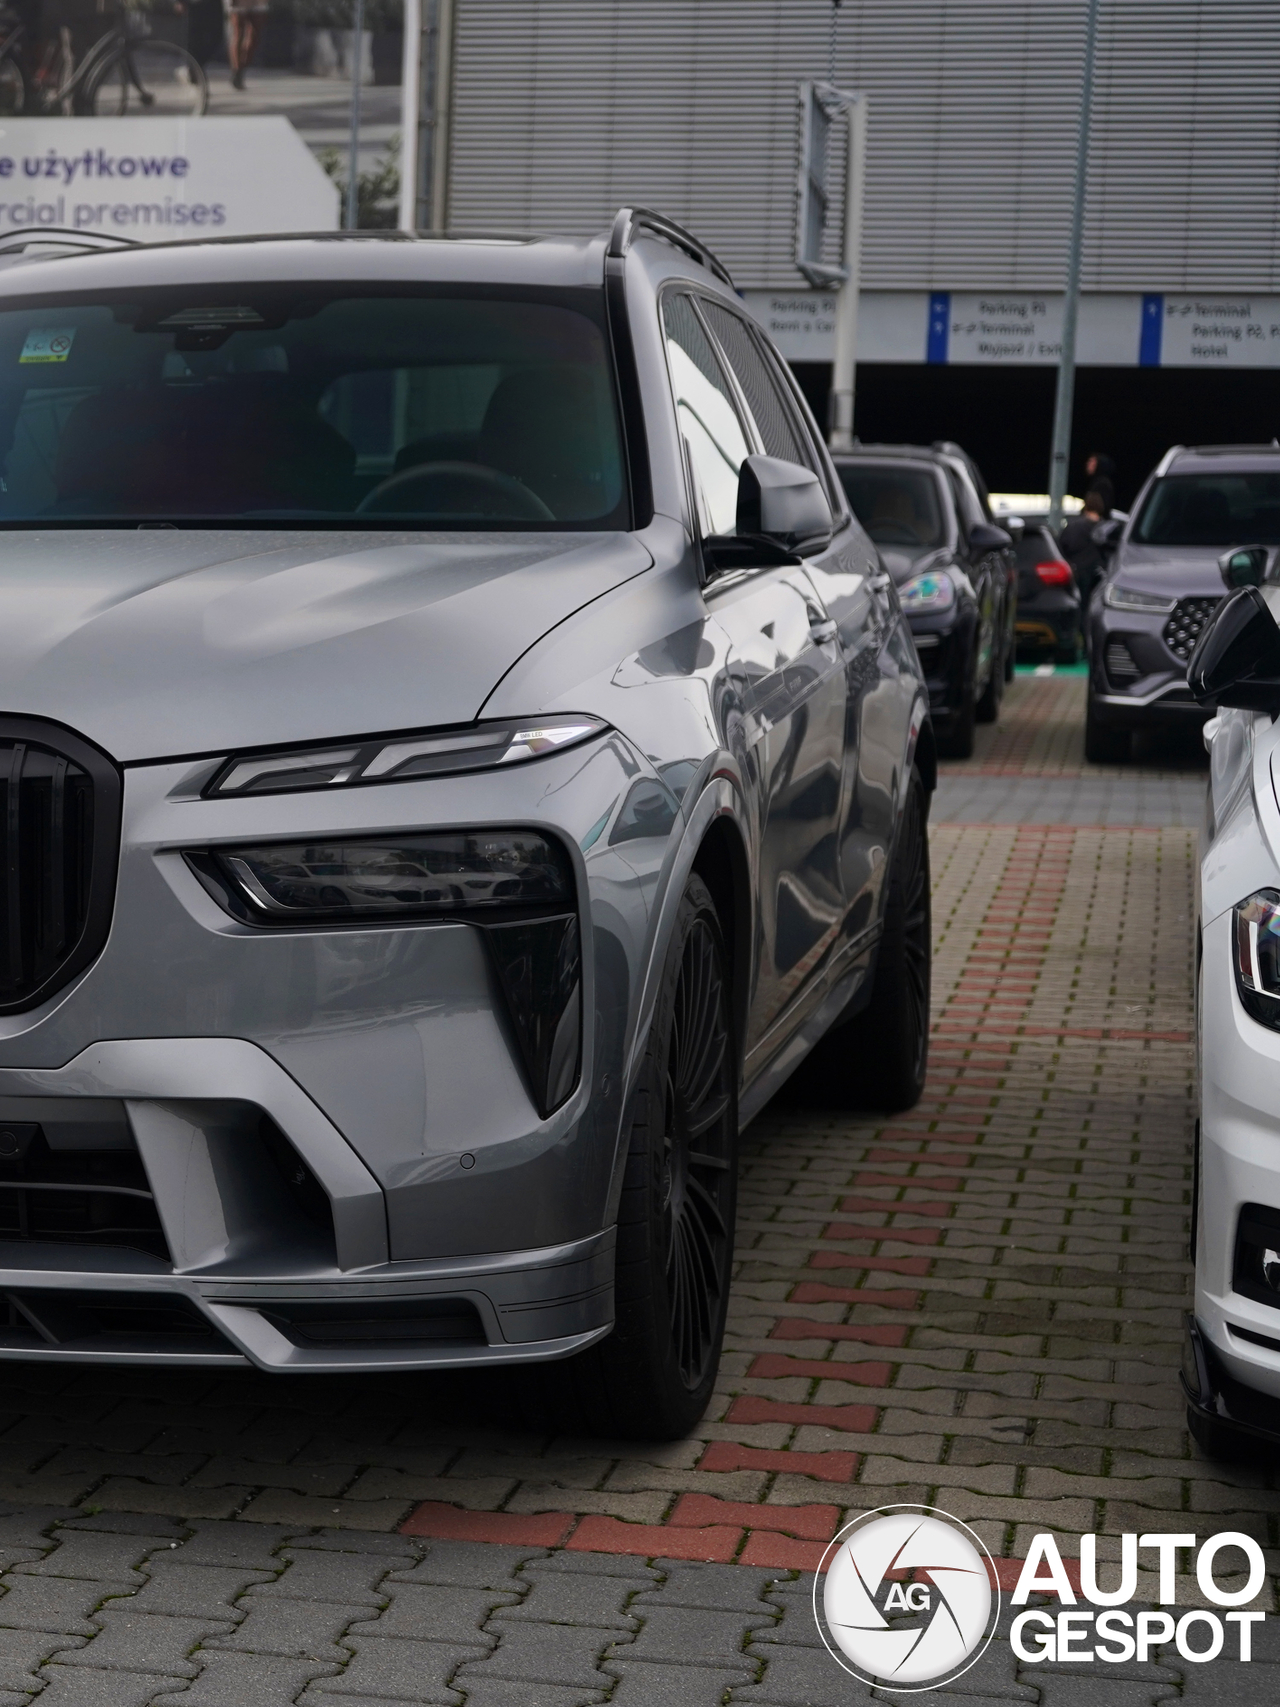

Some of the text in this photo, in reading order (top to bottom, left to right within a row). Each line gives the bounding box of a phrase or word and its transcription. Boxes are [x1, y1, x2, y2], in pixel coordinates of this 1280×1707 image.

[23, 149, 190, 186] użytkowe
[73, 196, 226, 228] premises
[979, 301, 1028, 318] Parking
[1194, 303, 1251, 318] Terminal
[980, 321, 1035, 336] Terminal
[1192, 322, 1242, 342] Parking
[1270, 323, 1280, 338] P
[1191, 343, 1228, 358] Hotel
